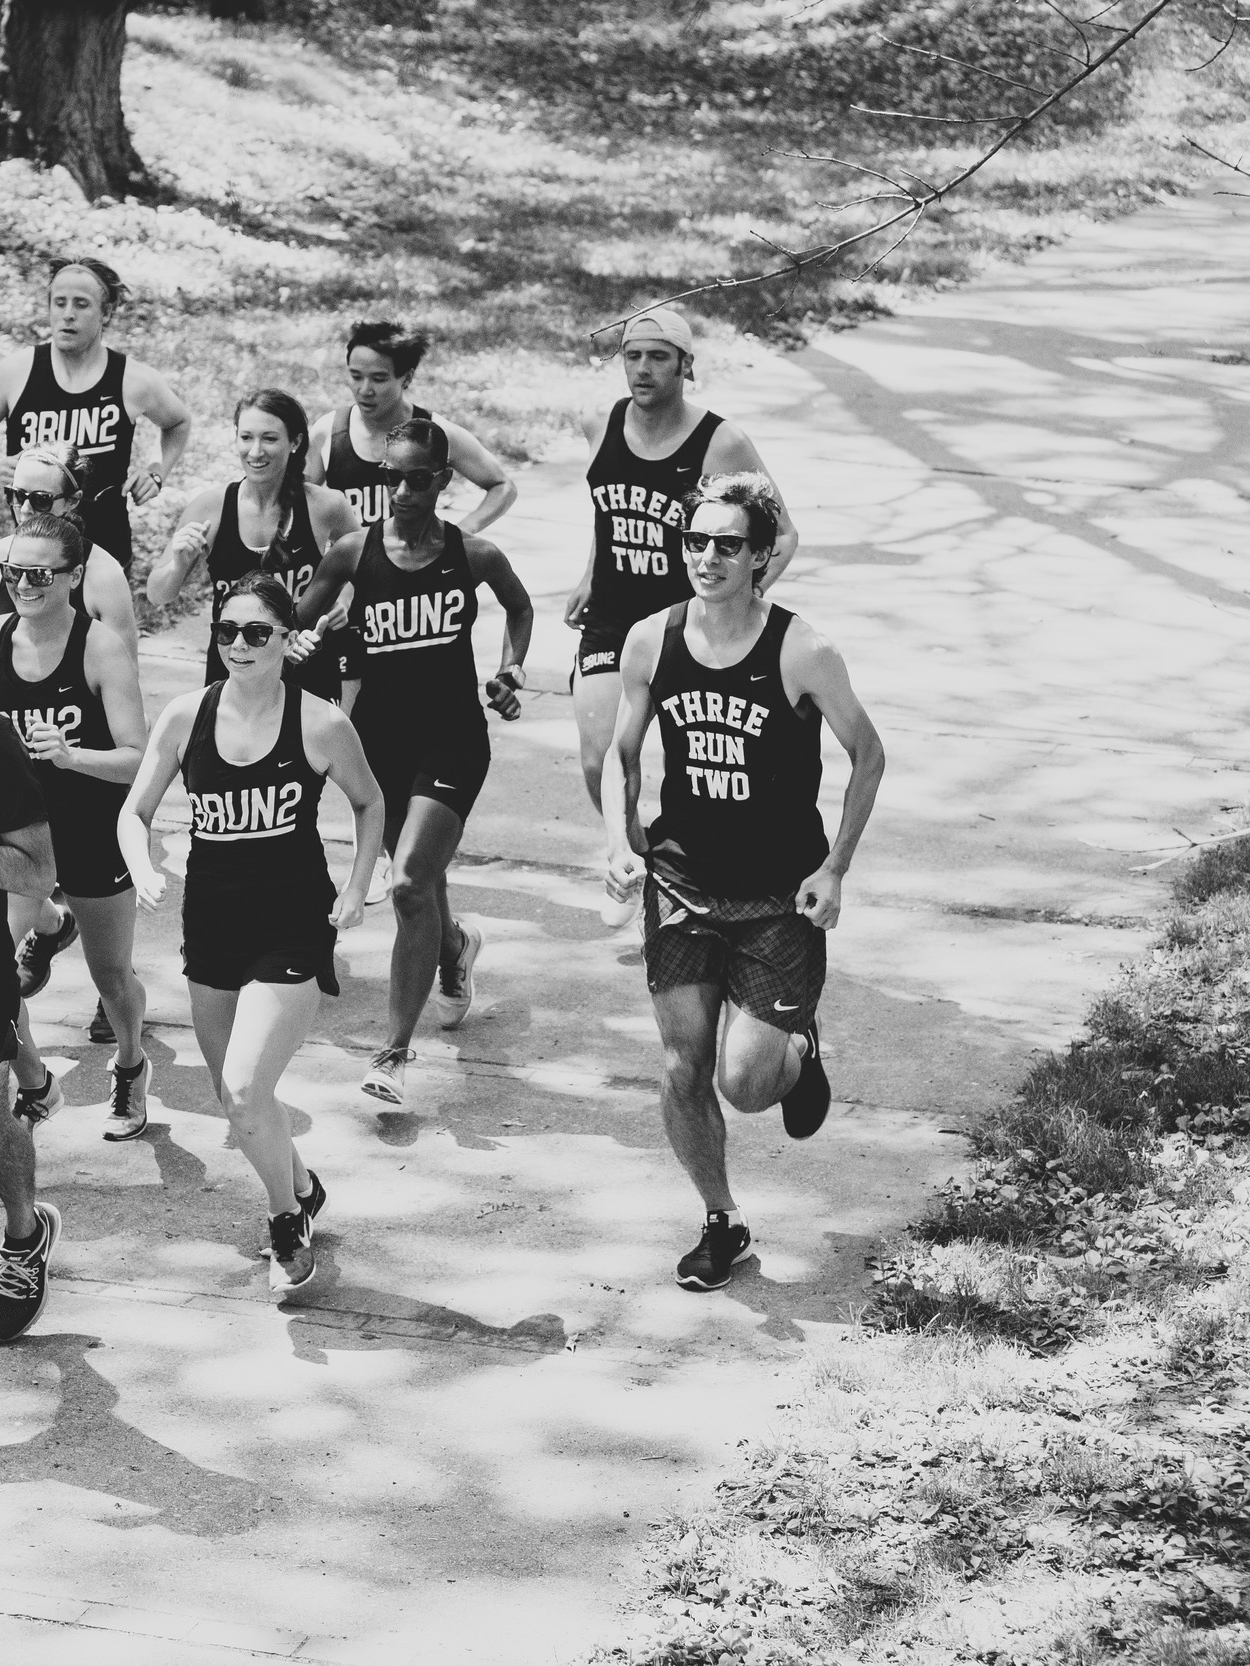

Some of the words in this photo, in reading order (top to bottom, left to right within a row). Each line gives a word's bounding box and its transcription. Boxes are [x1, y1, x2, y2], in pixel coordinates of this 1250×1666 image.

[20, 404, 120, 450] 3RUN2
[593, 484, 685, 527] THREE
[611, 515, 664, 548] RUN
[611, 545, 669, 576] TWO
[363, 588, 465, 643] 3RUN2
[661, 691, 770, 737] THREE
[686, 730, 746, 766] RUN
[686, 765, 750, 801] TWO
[188, 781, 303, 833] 3RUN2
